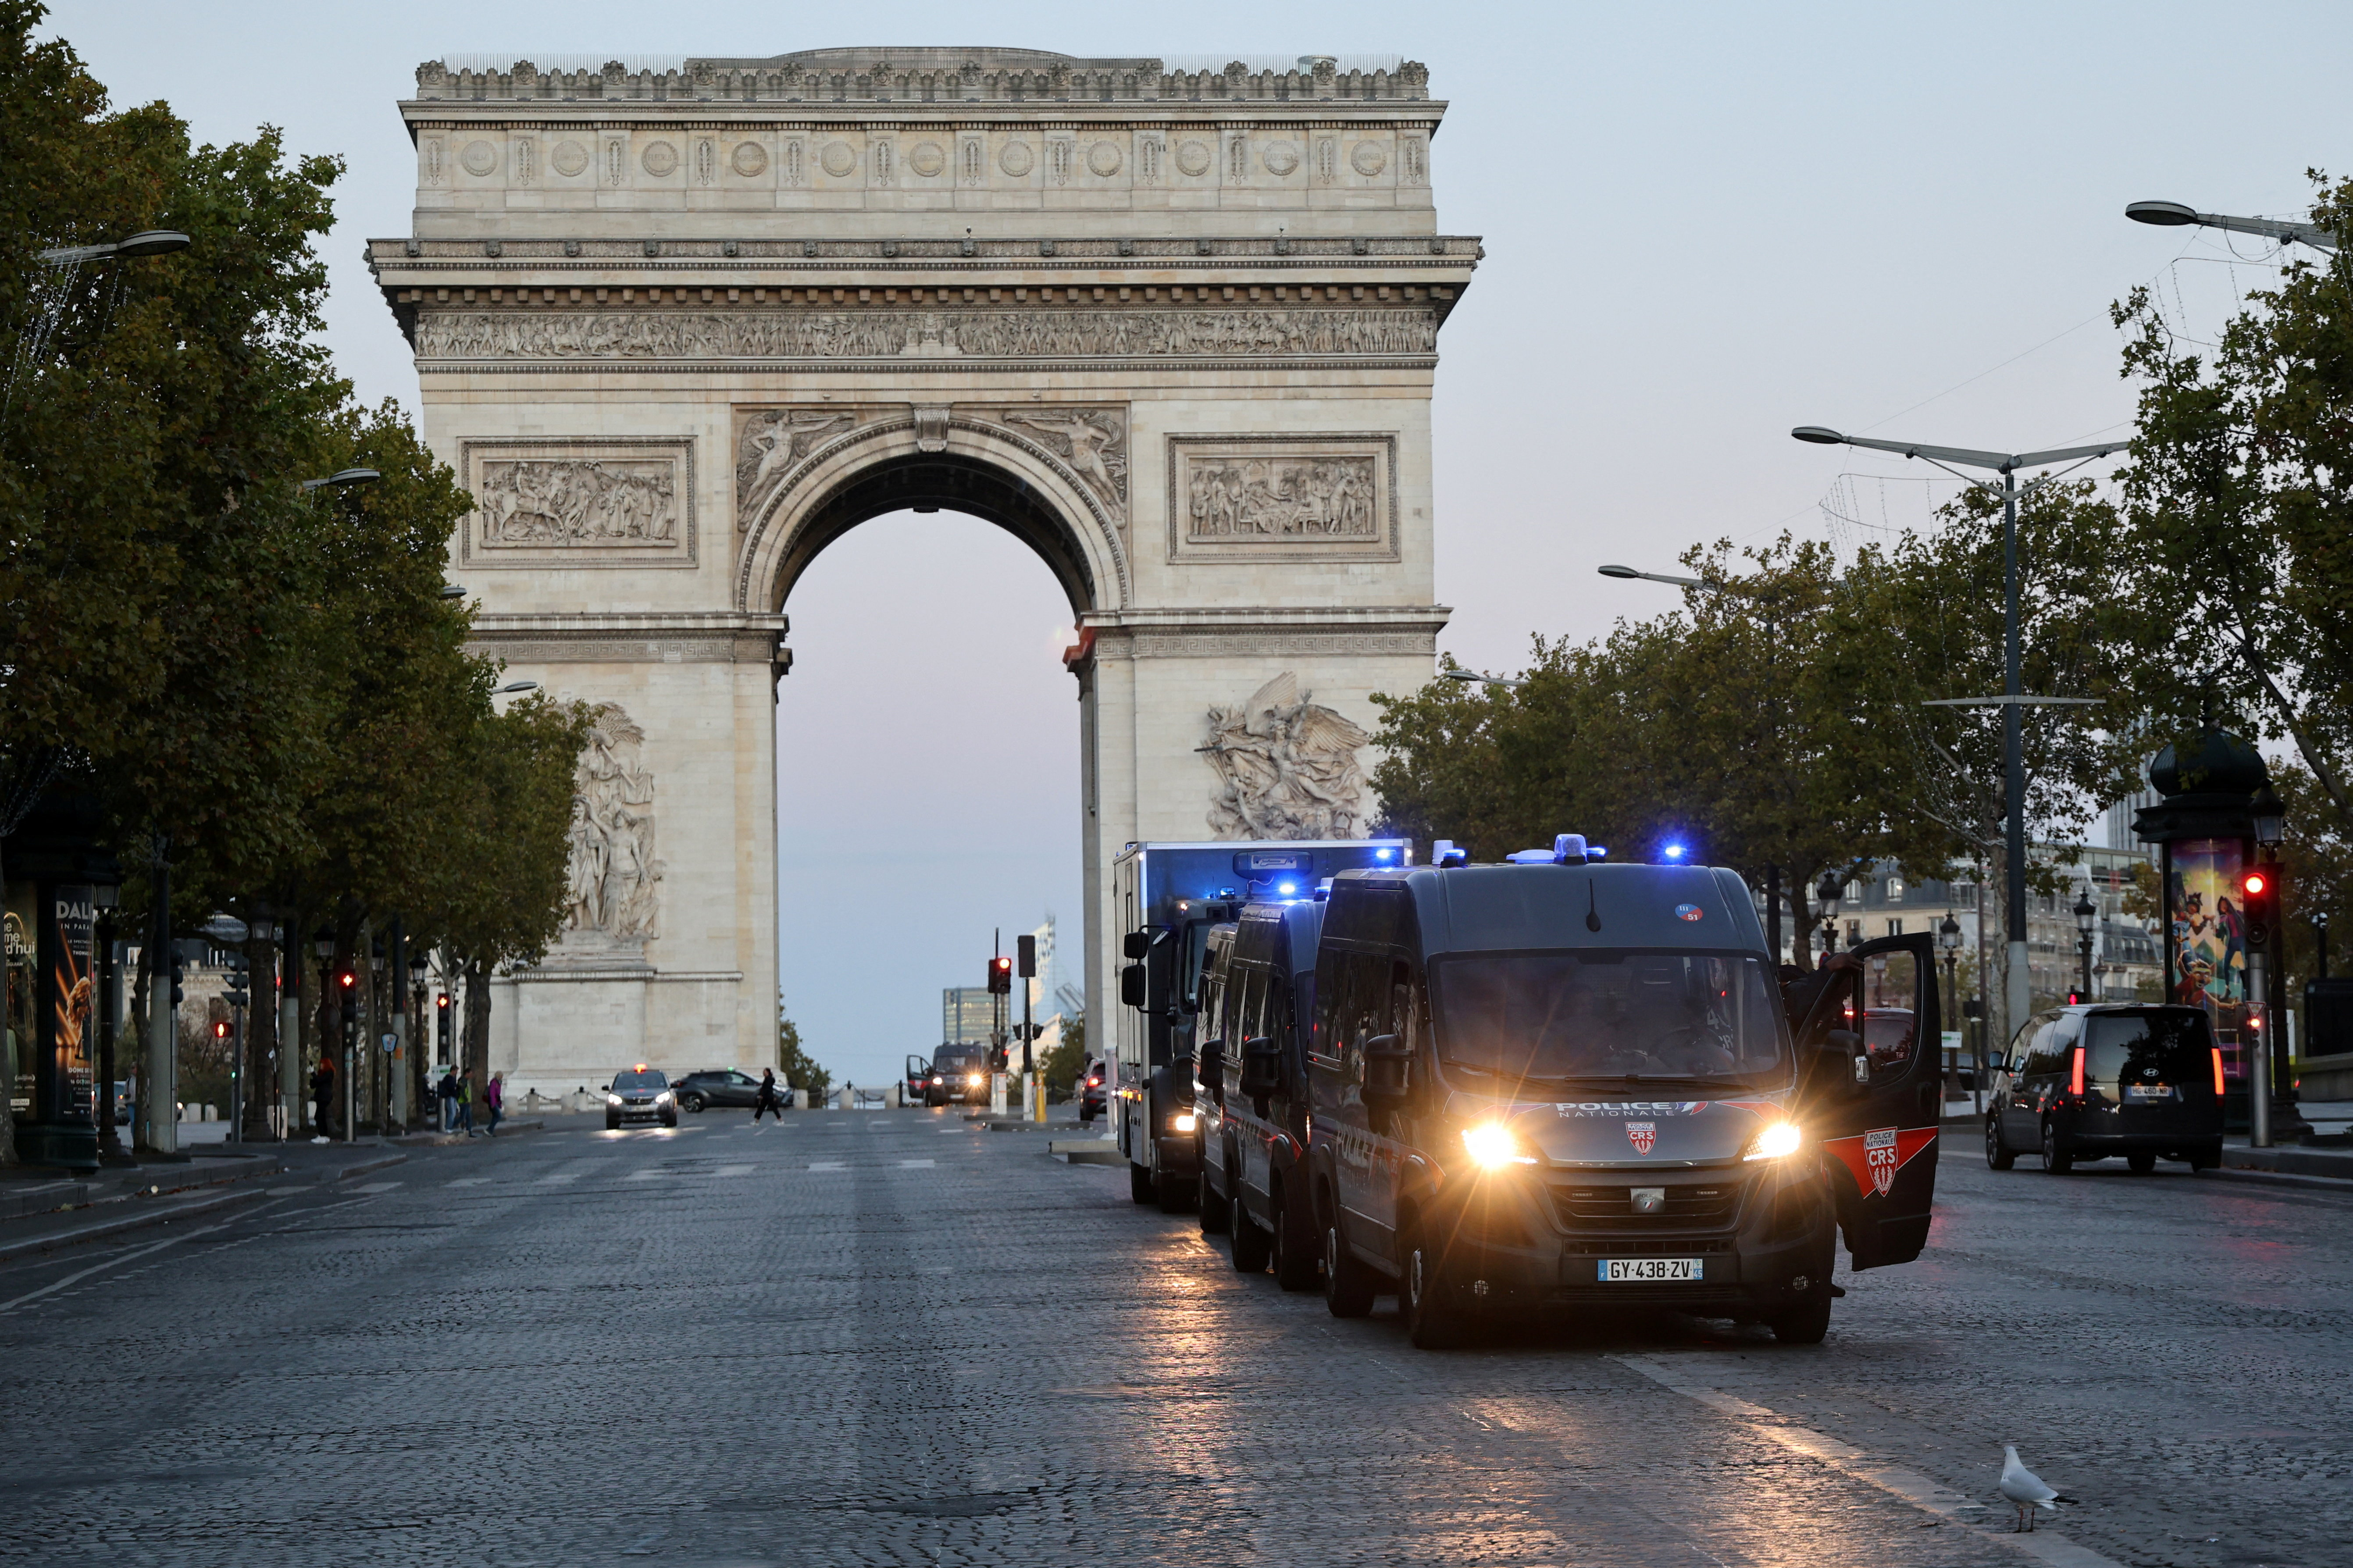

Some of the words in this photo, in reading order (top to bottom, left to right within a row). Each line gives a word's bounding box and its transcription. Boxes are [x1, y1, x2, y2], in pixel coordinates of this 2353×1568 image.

[4, 941, 36, 955] d'hui
[1556, 1102, 1672, 1111] POLICE
[1629, 1131, 1654, 1140] CRS
[1869, 1131, 1893, 1140] POLICE
[1866, 1138, 1894, 1148] NATIONALE
[1868, 1147, 1896, 1167] CRS
[1611, 1261, 1690, 1279] GY-438-ZV
[1693, 1269, 1703, 1279] 45
